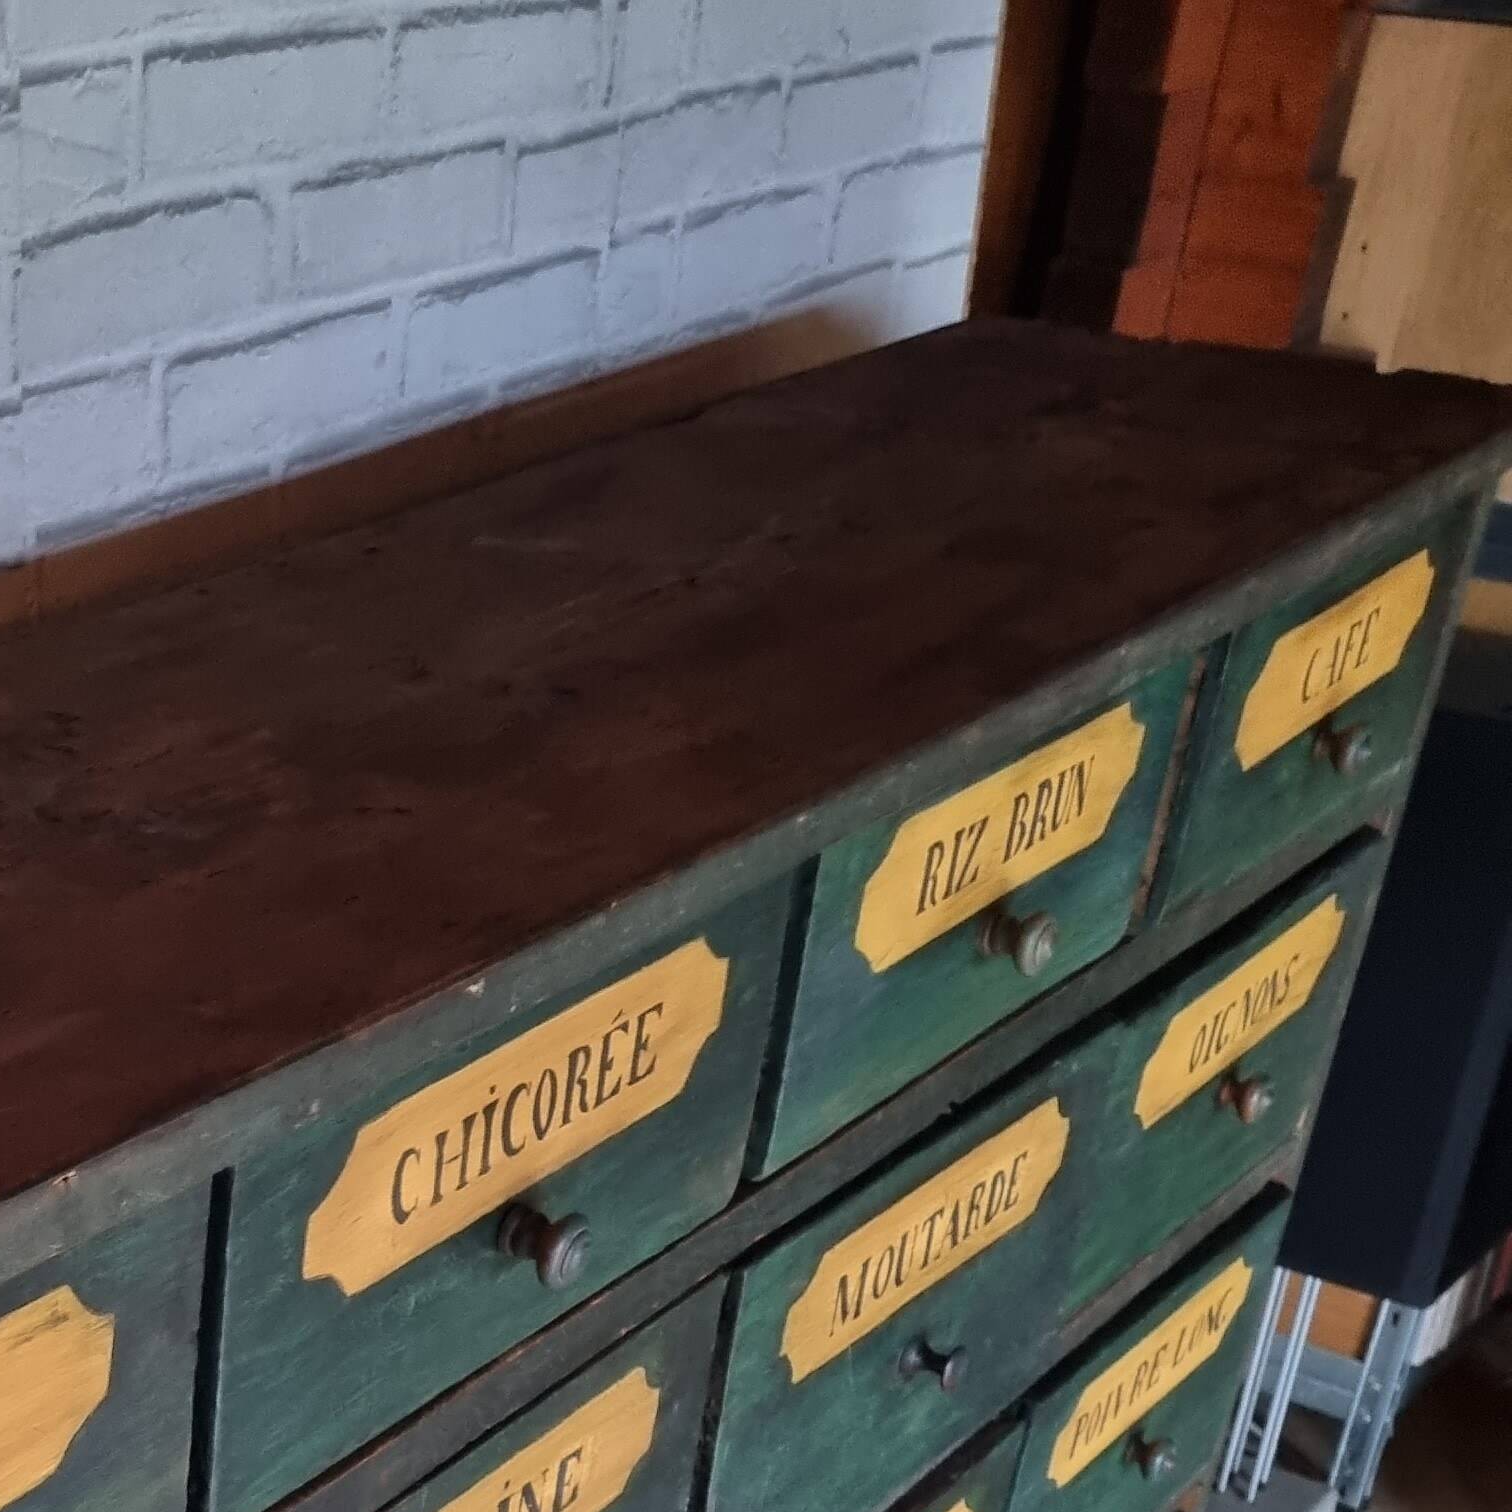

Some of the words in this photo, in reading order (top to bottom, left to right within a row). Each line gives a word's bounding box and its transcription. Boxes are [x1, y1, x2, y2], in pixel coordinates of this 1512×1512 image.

[916, 815, 990, 916] RIZ
[1003, 754, 1095, 864] BRUN
[391, 1002, 664, 1225] CHICORÉE
[829, 1151, 1028, 1337] MOUTARDE
[1069, 1342, 1169, 1460] POIVRE
